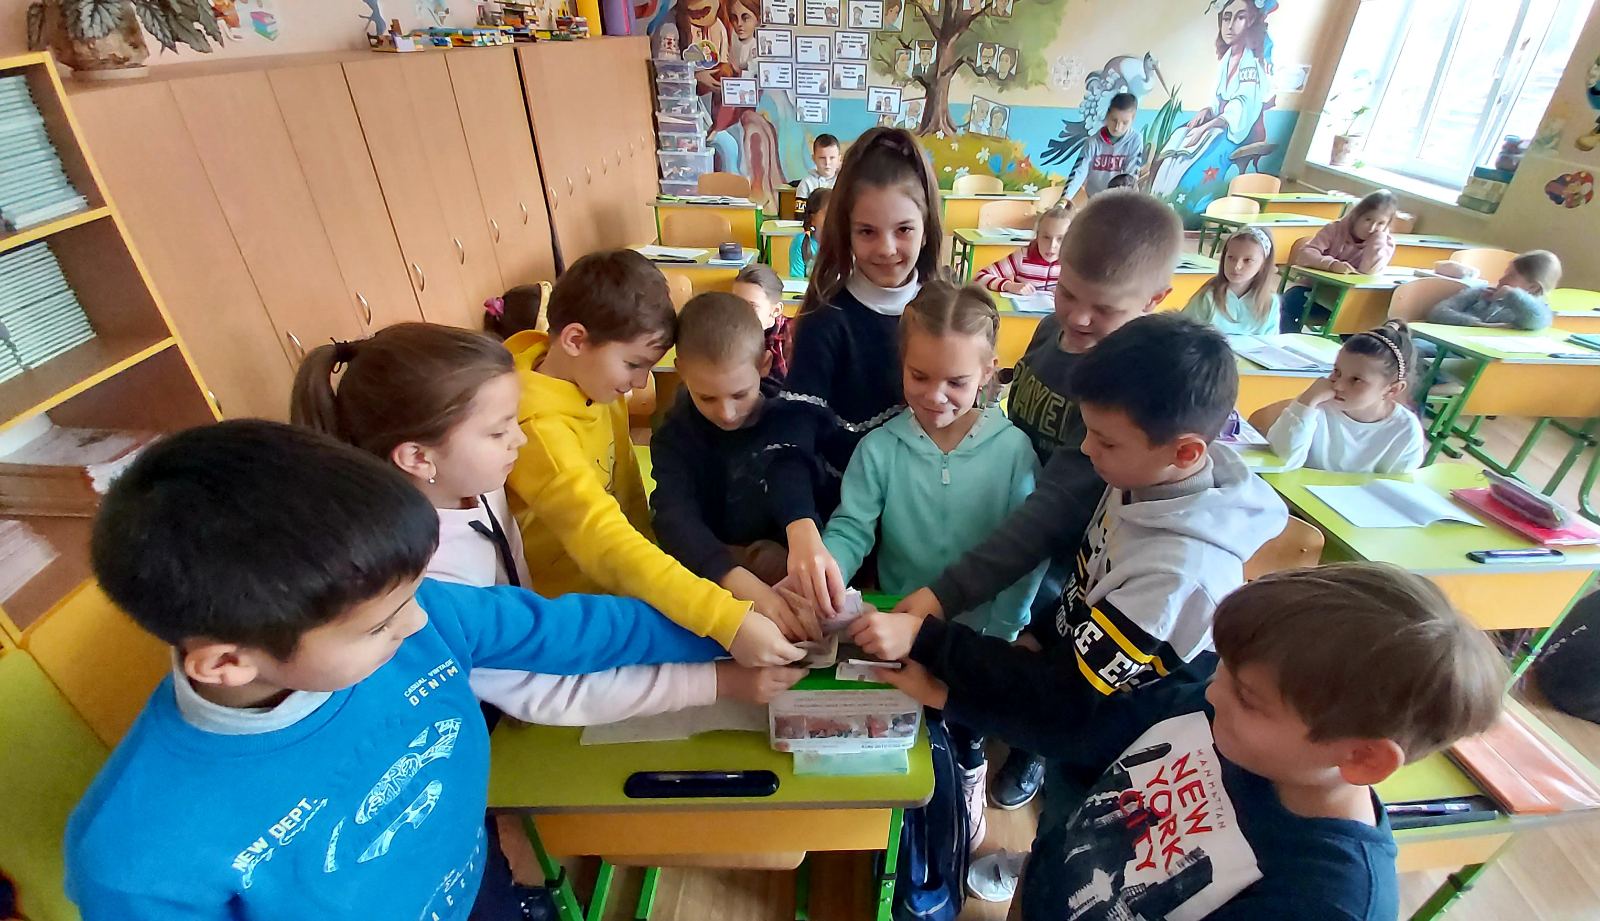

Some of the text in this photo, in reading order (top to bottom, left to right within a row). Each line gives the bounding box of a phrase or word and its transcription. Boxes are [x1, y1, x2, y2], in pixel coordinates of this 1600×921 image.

[404, 658, 454, 697] CASUAL VINTAGE
[409, 666, 459, 706] DENIM
[1146, 765, 1184, 874] YORK
[1171, 752, 1213, 835] NEW
[1197, 748, 1227, 829] MANHATTAN
[232, 837, 268, 872] NEW
[269, 798, 319, 838] DEPT.
[1120, 790, 1157, 871] CITY
